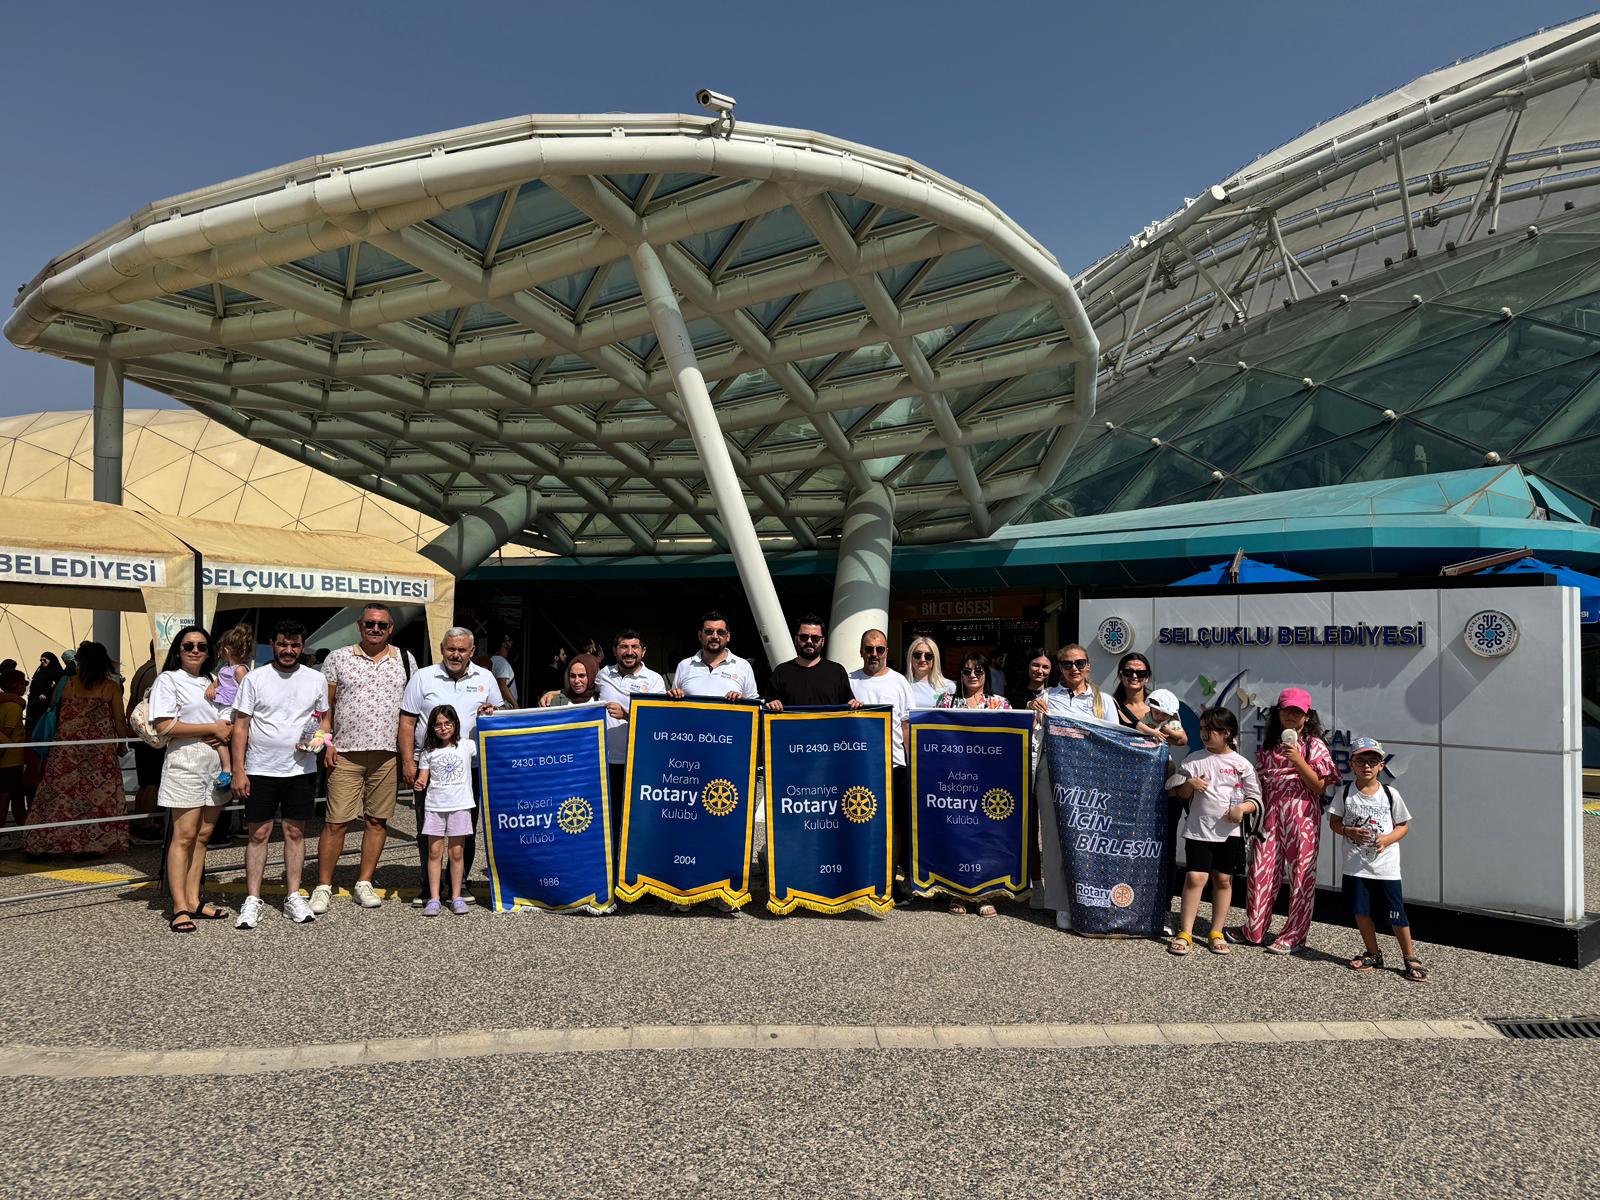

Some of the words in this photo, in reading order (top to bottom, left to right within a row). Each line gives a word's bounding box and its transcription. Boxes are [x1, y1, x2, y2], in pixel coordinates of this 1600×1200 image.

[0, 553, 157, 582] BELEDİYESİ
[202, 567, 314, 592] SELÇUKLU
[321, 575, 428, 598] BELEDİYESİ
[922, 600, 953, 616] BİLET
[955, 596, 993, 616] GİŞESİ
[1158, 625, 1272, 648] SELÇUKLU
[1277, 621, 1426, 648] BELEDİYESİ
[653, 732, 669, 742] UR
[671, 732, 696, 743] 2430.
[698, 731, 733, 744] BÖLGE
[789, 743, 804, 753] UR
[806, 743, 831, 753] 2430.
[833, 741, 868, 752] BÖLGE
[923, 743, 939, 753] UR
[966, 743, 1003, 755] BÖLGE
[511, 756, 537, 768] 2430.
[539, 753, 574, 766] BÖLGE
[668, 757, 701, 770] Konya
[662, 773, 700, 785] Meram
[948, 770, 979, 781] Adana
[786, 784, 838, 798] Osmaniye
[938, 781, 979, 793] Taşköprü
[640, 784, 698, 806] Rotary
[517, 797, 553, 811] Kayseri
[781, 797, 838, 816] Rotary
[926, 793, 978, 813] Rotary
[498, 811, 553, 830] Rotary
[661, 808, 698, 821] Kulübü
[946, 814, 979, 825] Kulübü
[1068, 806, 1112, 833] İÇİN
[804, 818, 839, 831] Kulübü
[519, 831, 555, 845] Kulübü
[1075, 833, 1163, 859] BİRLEŞİN
[673, 855, 696, 865] 2004
[819, 864, 842, 874] 2019
[958, 863, 982, 873] 2019
[539, 877, 560, 887] 1986
[1075, 883, 1112, 900] Rotary
